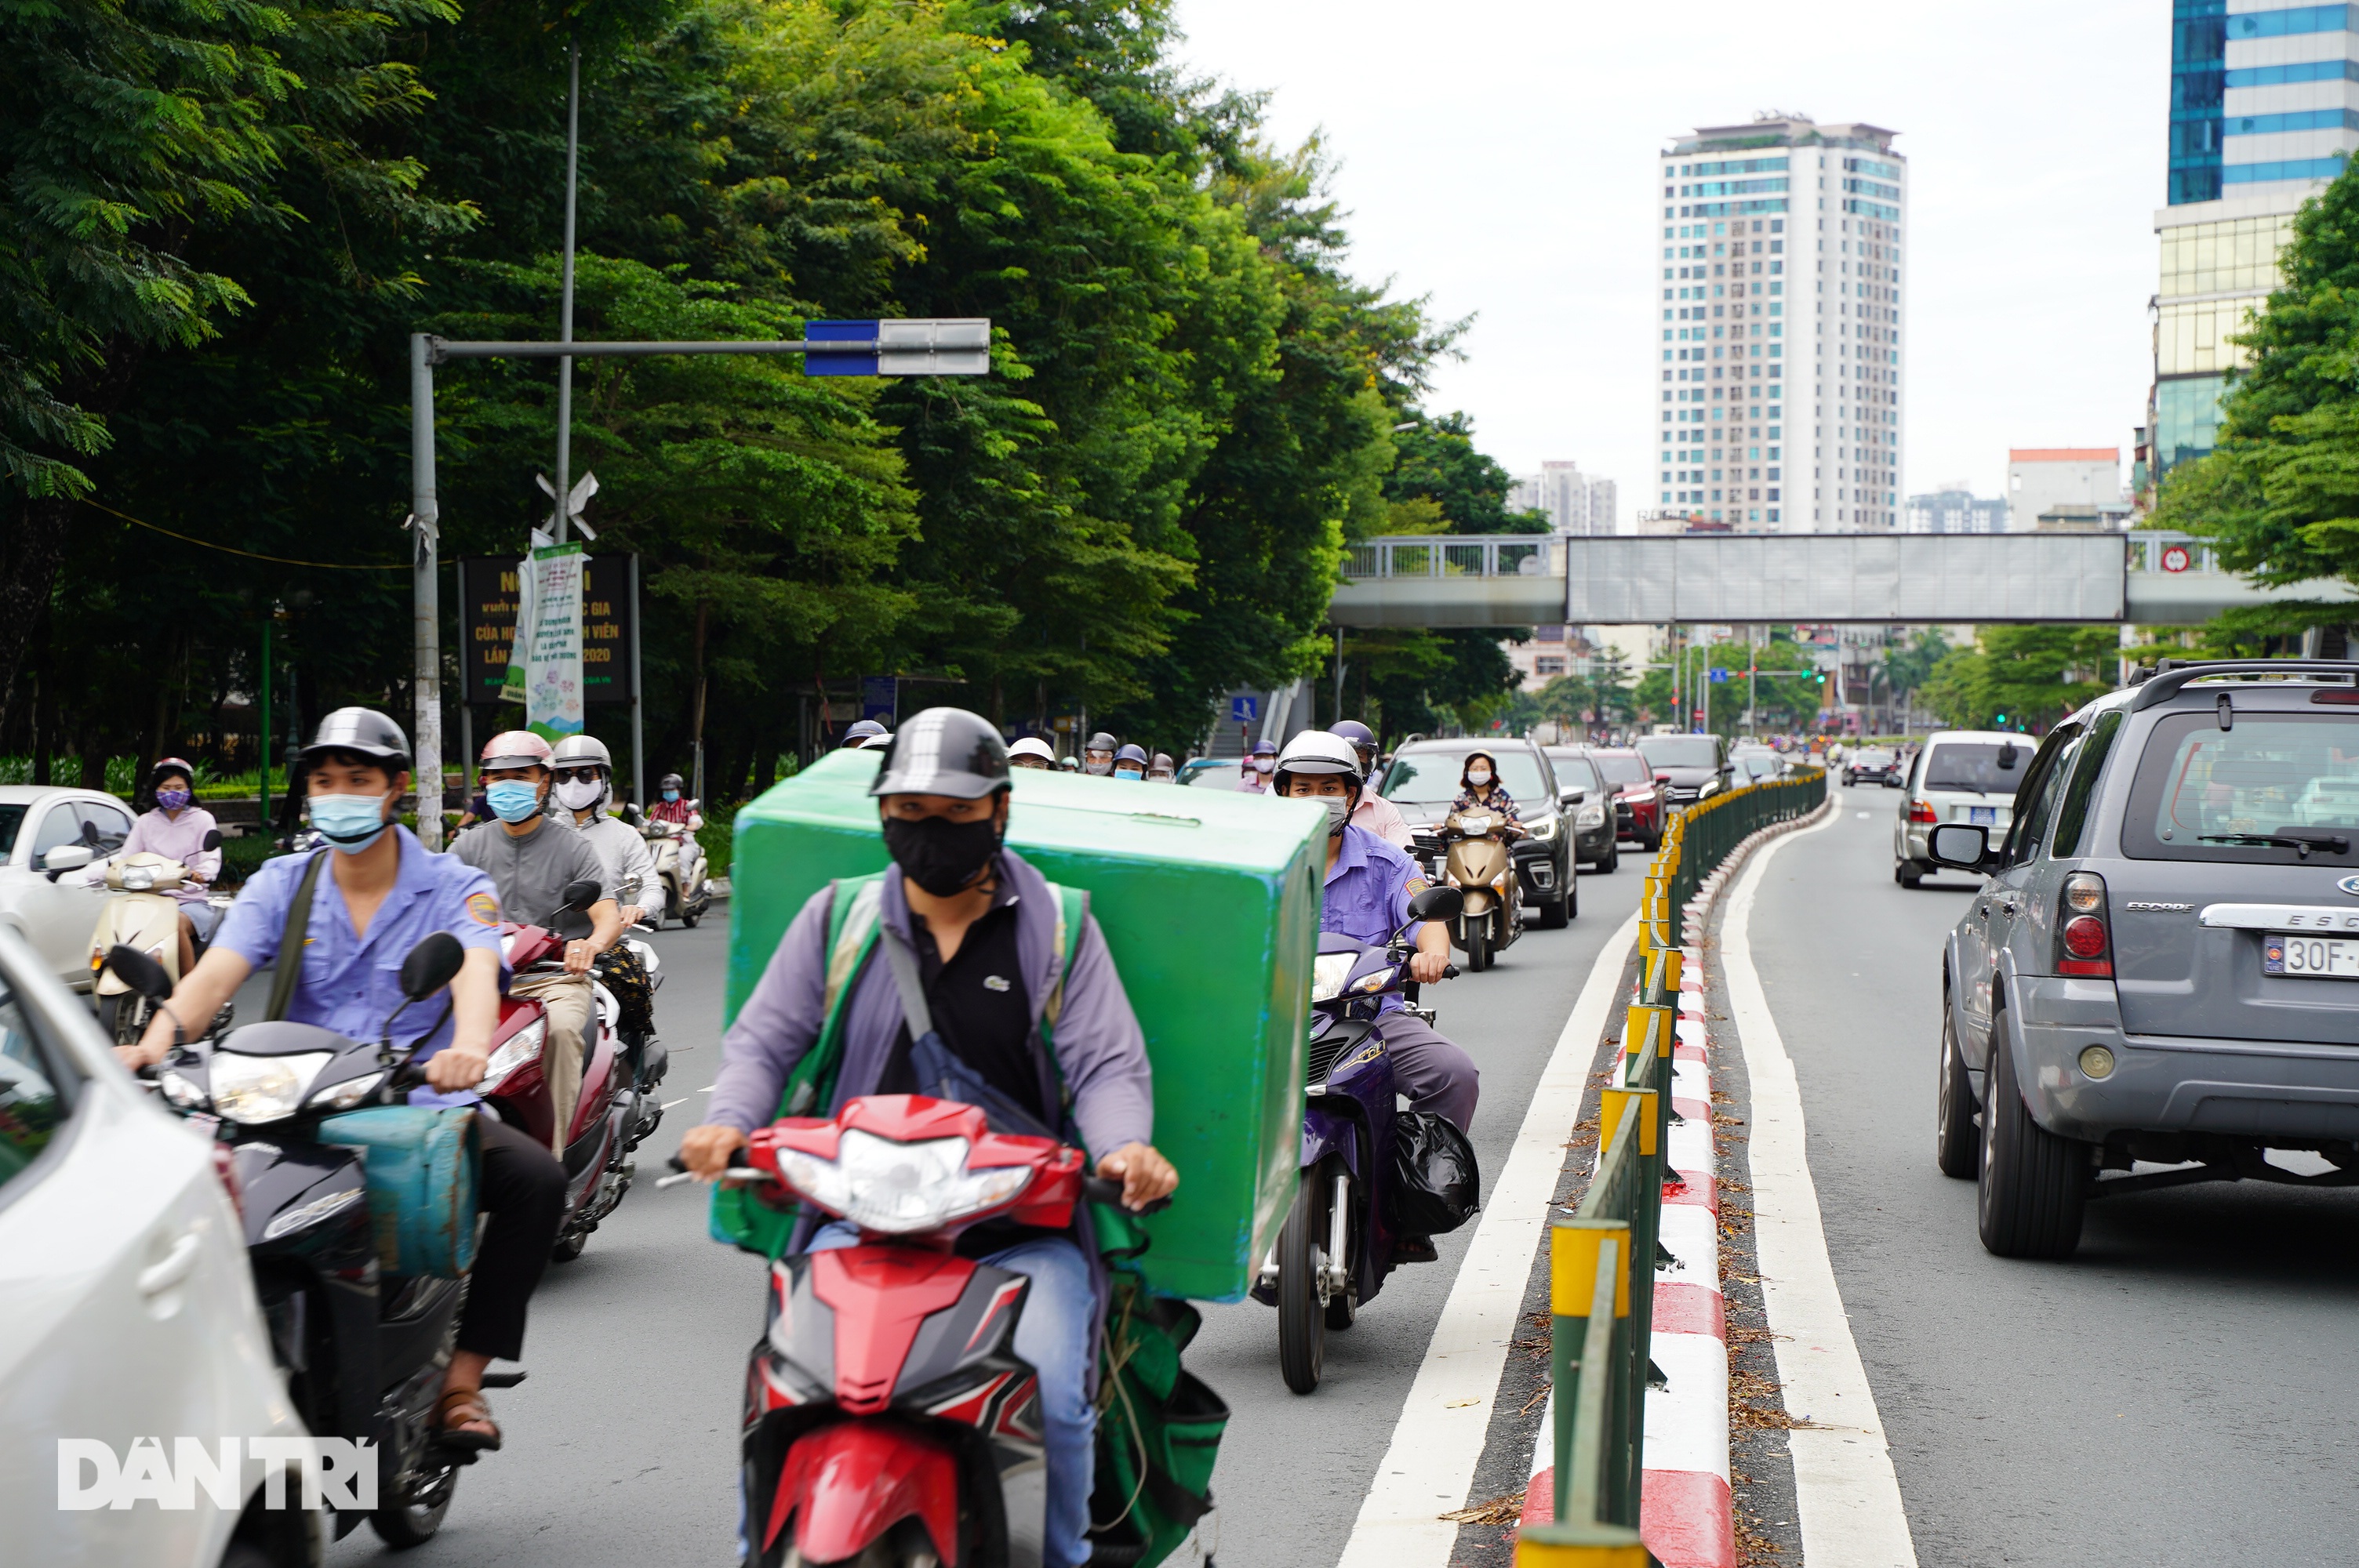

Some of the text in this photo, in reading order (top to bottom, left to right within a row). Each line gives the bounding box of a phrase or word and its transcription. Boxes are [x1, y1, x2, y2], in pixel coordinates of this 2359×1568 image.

[591, 601, 611, 616] GIA
[475, 623, 499, 641] CỦA
[592, 621, 620, 639] VIÊN
[583, 648, 611, 663] 2020
[2125, 902, 2195, 913] ESCAPE
